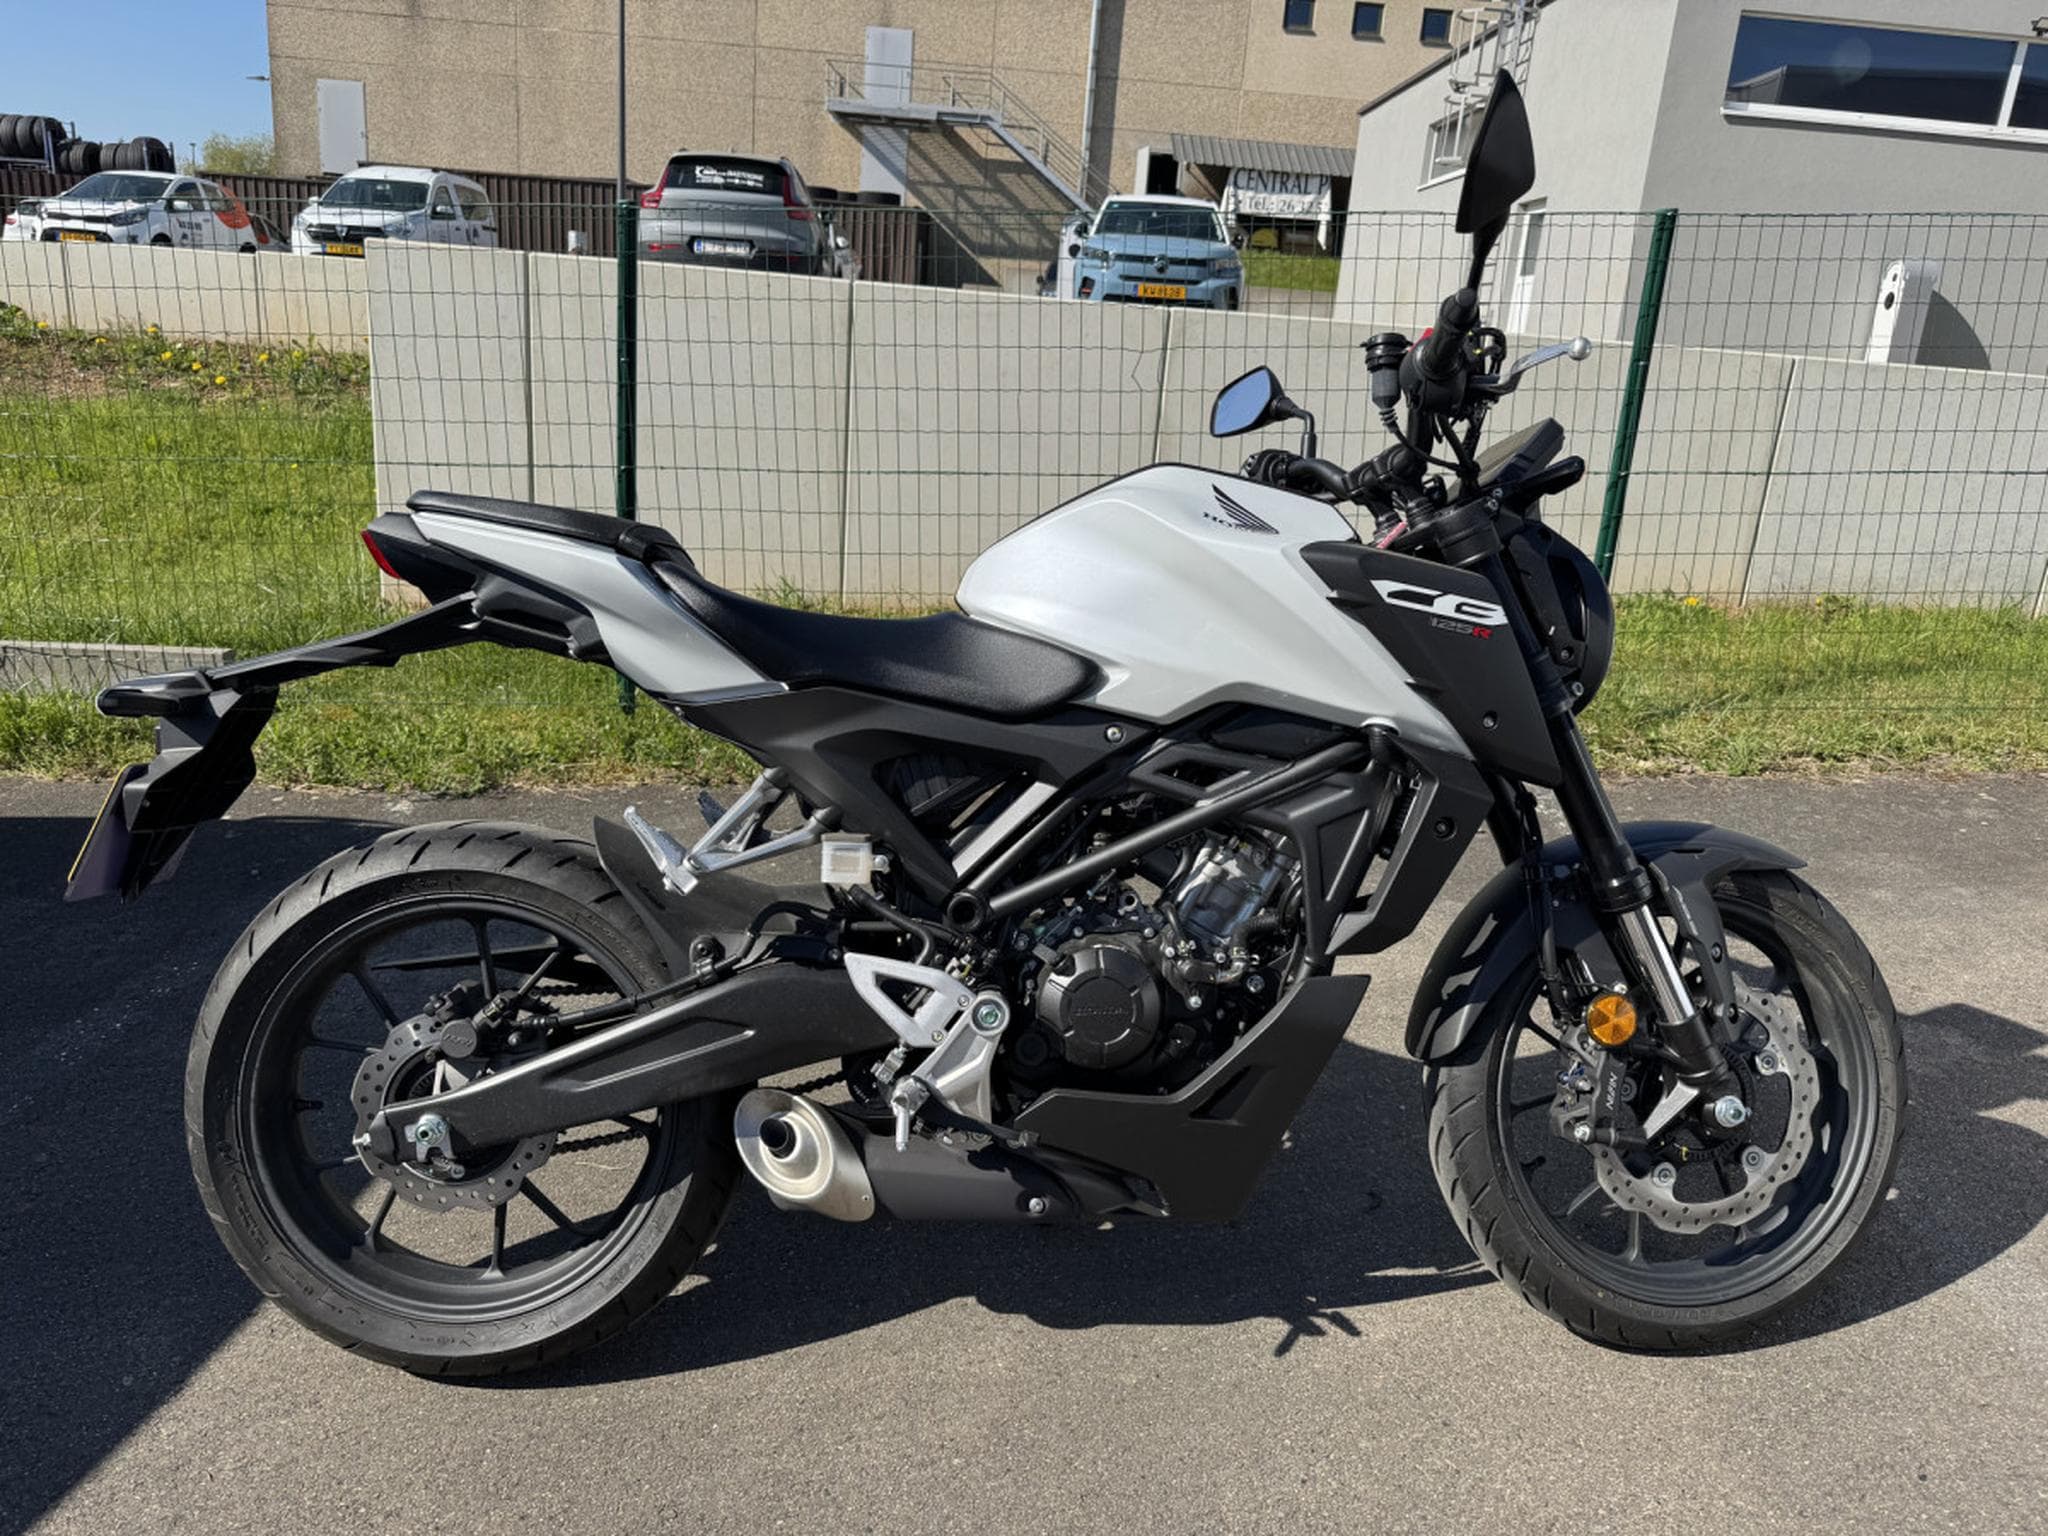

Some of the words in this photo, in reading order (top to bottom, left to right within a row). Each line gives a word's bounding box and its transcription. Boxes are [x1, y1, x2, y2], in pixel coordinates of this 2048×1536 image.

[1233, 168, 1312, 195] CENTRAL
[1369, 579, 1509, 626] CB
[1430, 616, 1494, 640] 125R
